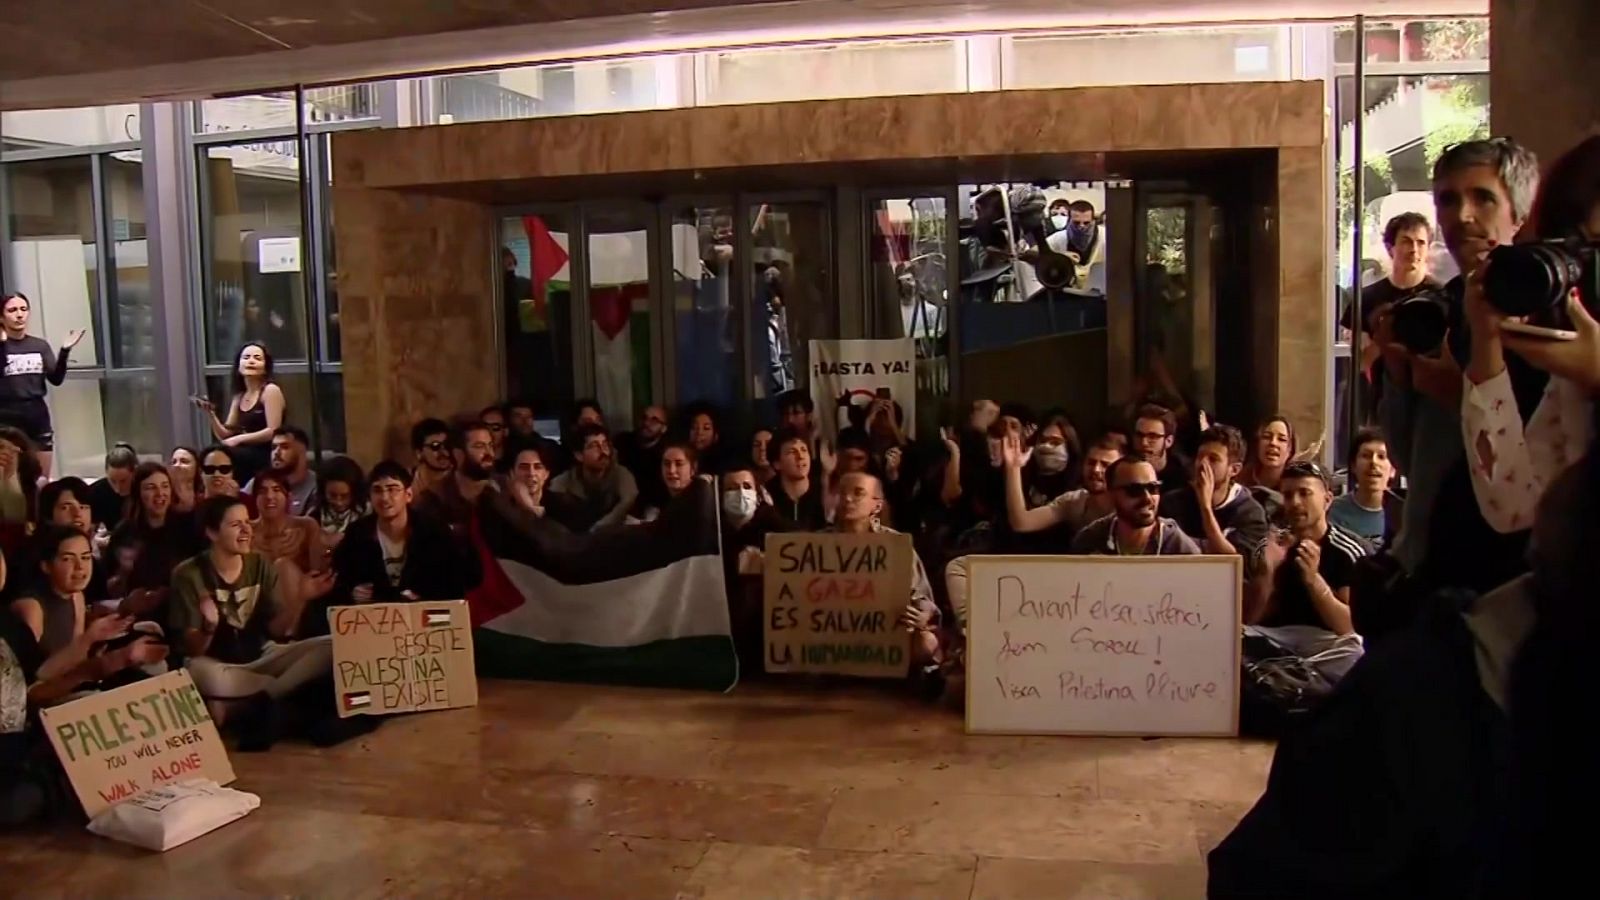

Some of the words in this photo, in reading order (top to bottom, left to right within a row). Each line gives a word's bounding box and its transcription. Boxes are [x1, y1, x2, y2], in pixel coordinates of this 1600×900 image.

[814, 361, 875, 377] ¡BASTA
[882, 360, 910, 375] YA!
[779, 541, 887, 574] SALVAR
[779, 582, 794, 600] A
[806, 576, 876, 603] GAZA
[335, 606, 412, 635] GAZA
[771, 607, 799, 631] ES
[810, 609, 886, 633] SALVAR
[393, 627, 466, 657] RESISTE
[338, 657, 446, 688] PALESTINA
[382, 678, 447, 708] EXISTE
[104, 756, 127, 770] YOU
[165, 729, 203, 749] NEVER
[98, 779, 140, 804] WALK
[151, 752, 201, 783] ALONE
